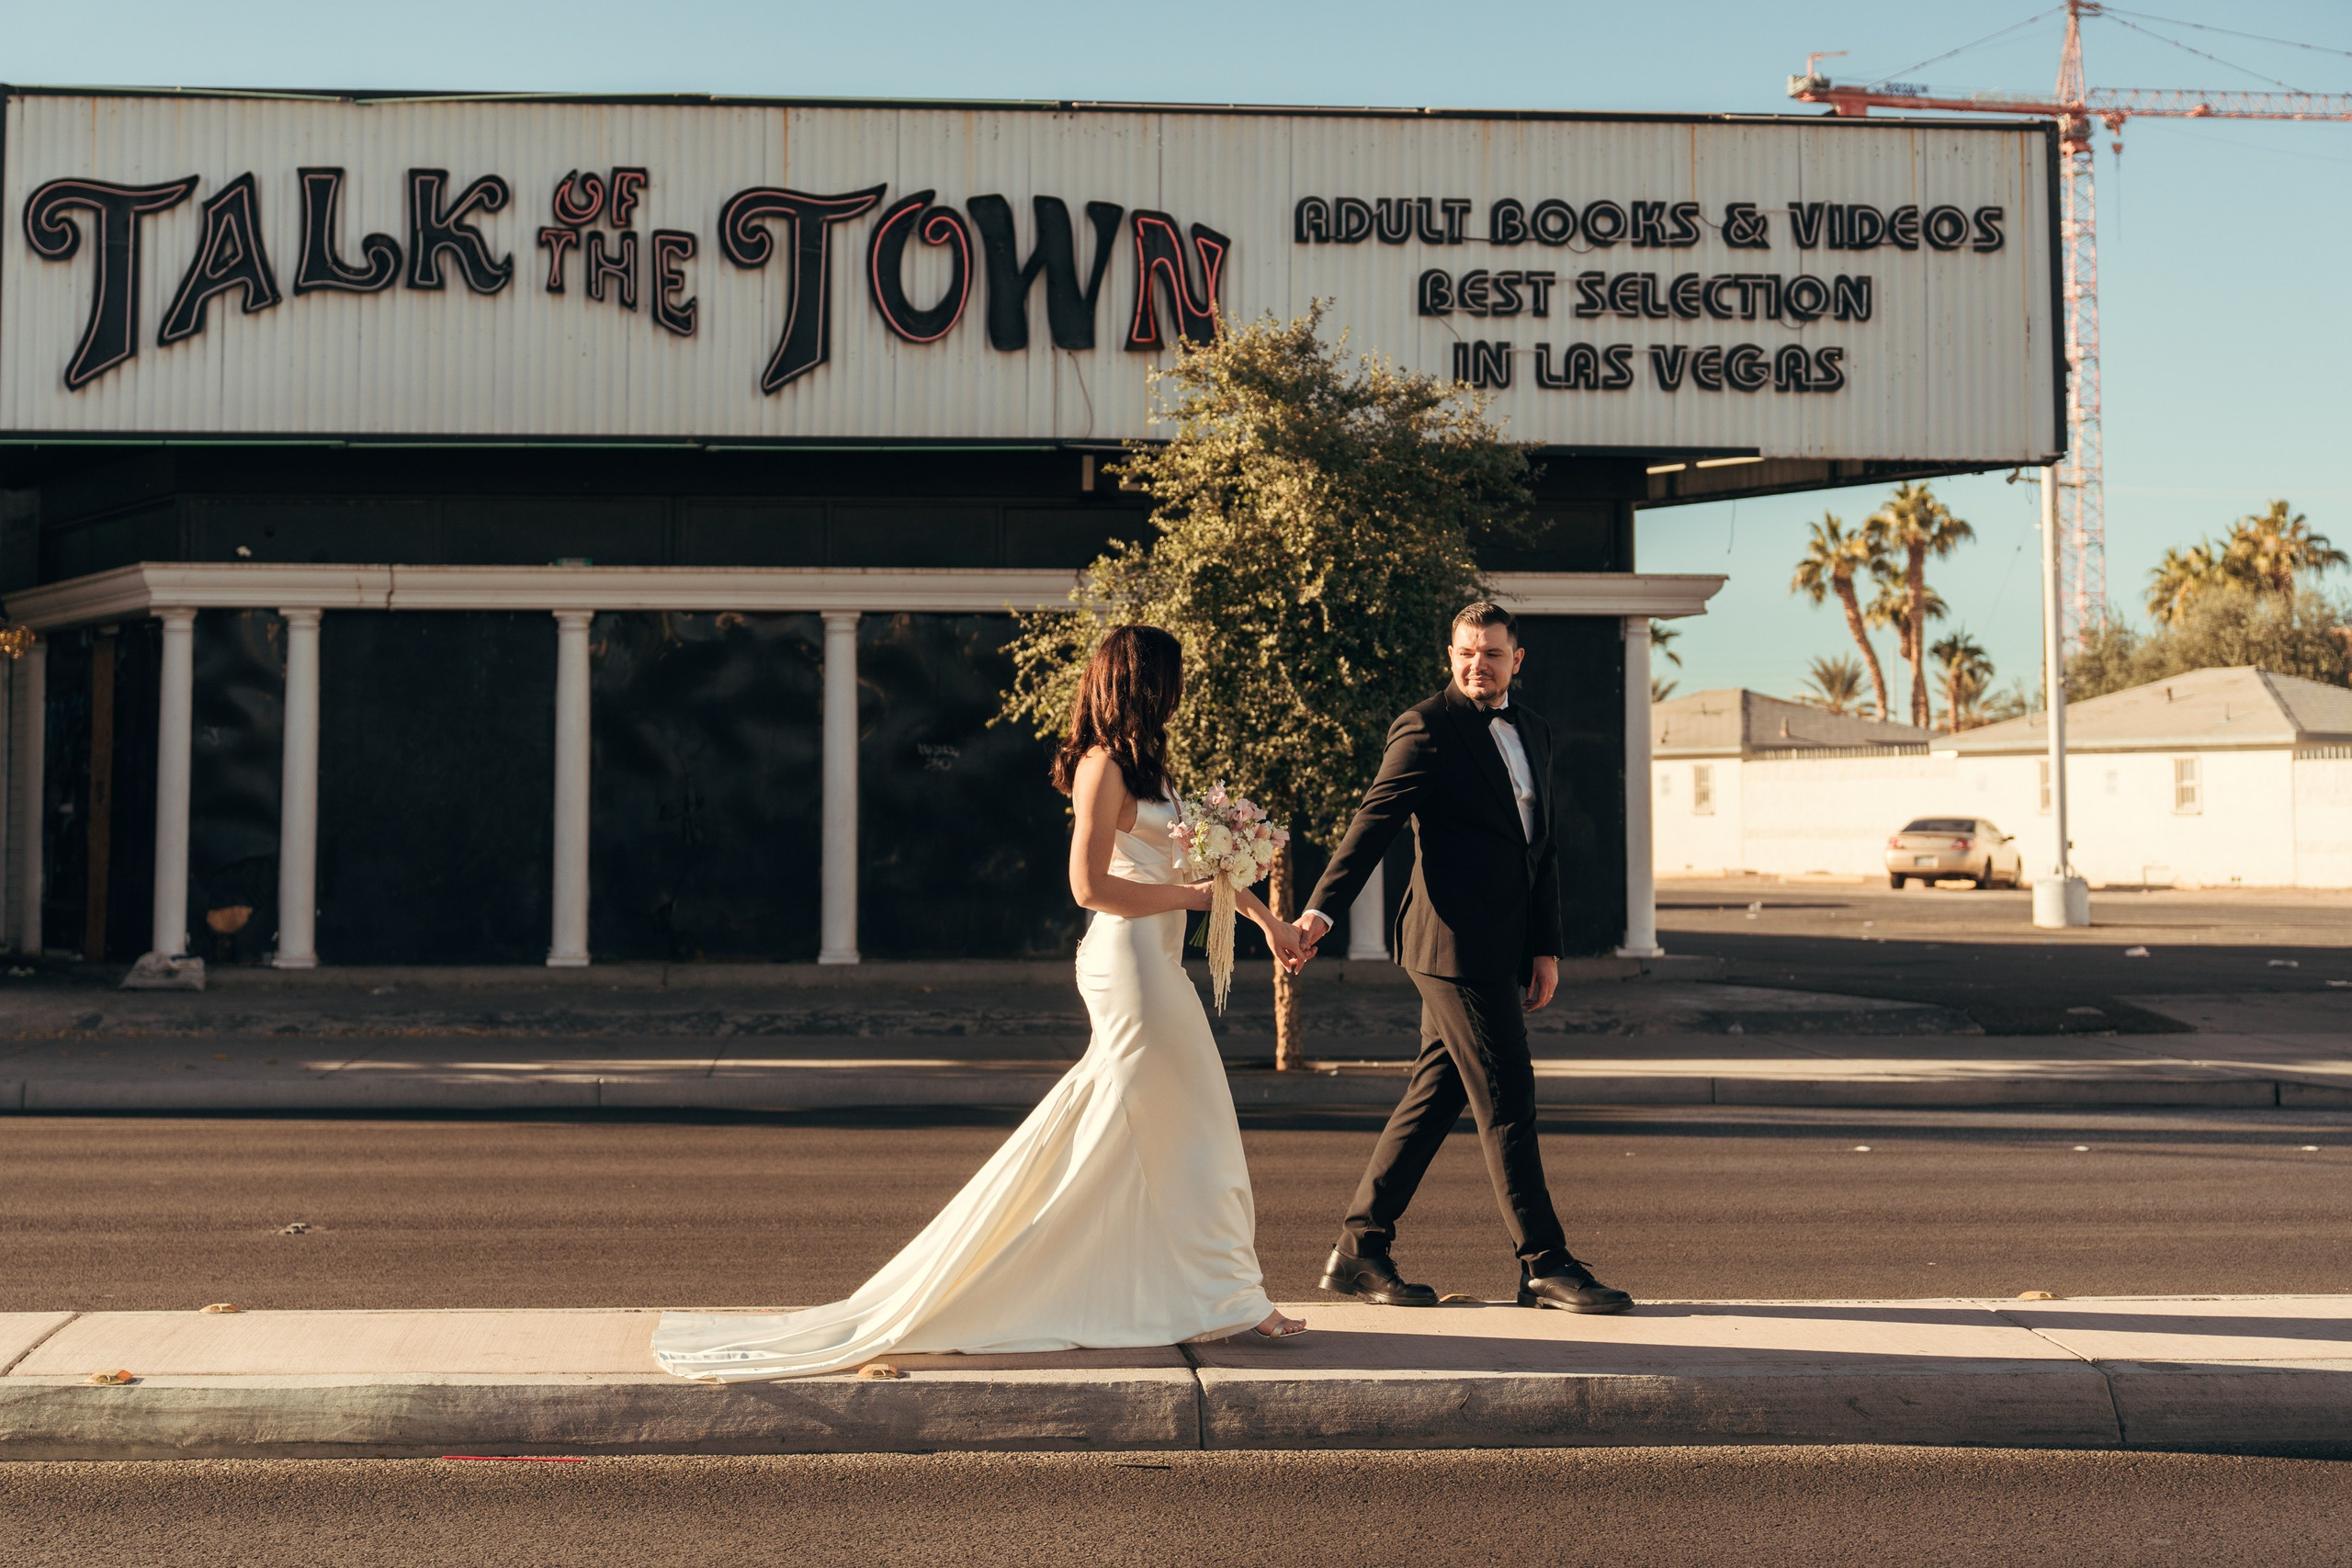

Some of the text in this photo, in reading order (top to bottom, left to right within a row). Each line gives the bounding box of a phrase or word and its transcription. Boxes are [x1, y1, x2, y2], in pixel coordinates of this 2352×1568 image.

[1294, 196, 2005, 252] ADULT BOOKS & VIDEOS
[23, 166, 1230, 396] TALK OF THE TOWN
[1418, 267, 1872, 321] BEST SELECTION
[1453, 341, 1845, 392] IN LAS VEGAS
